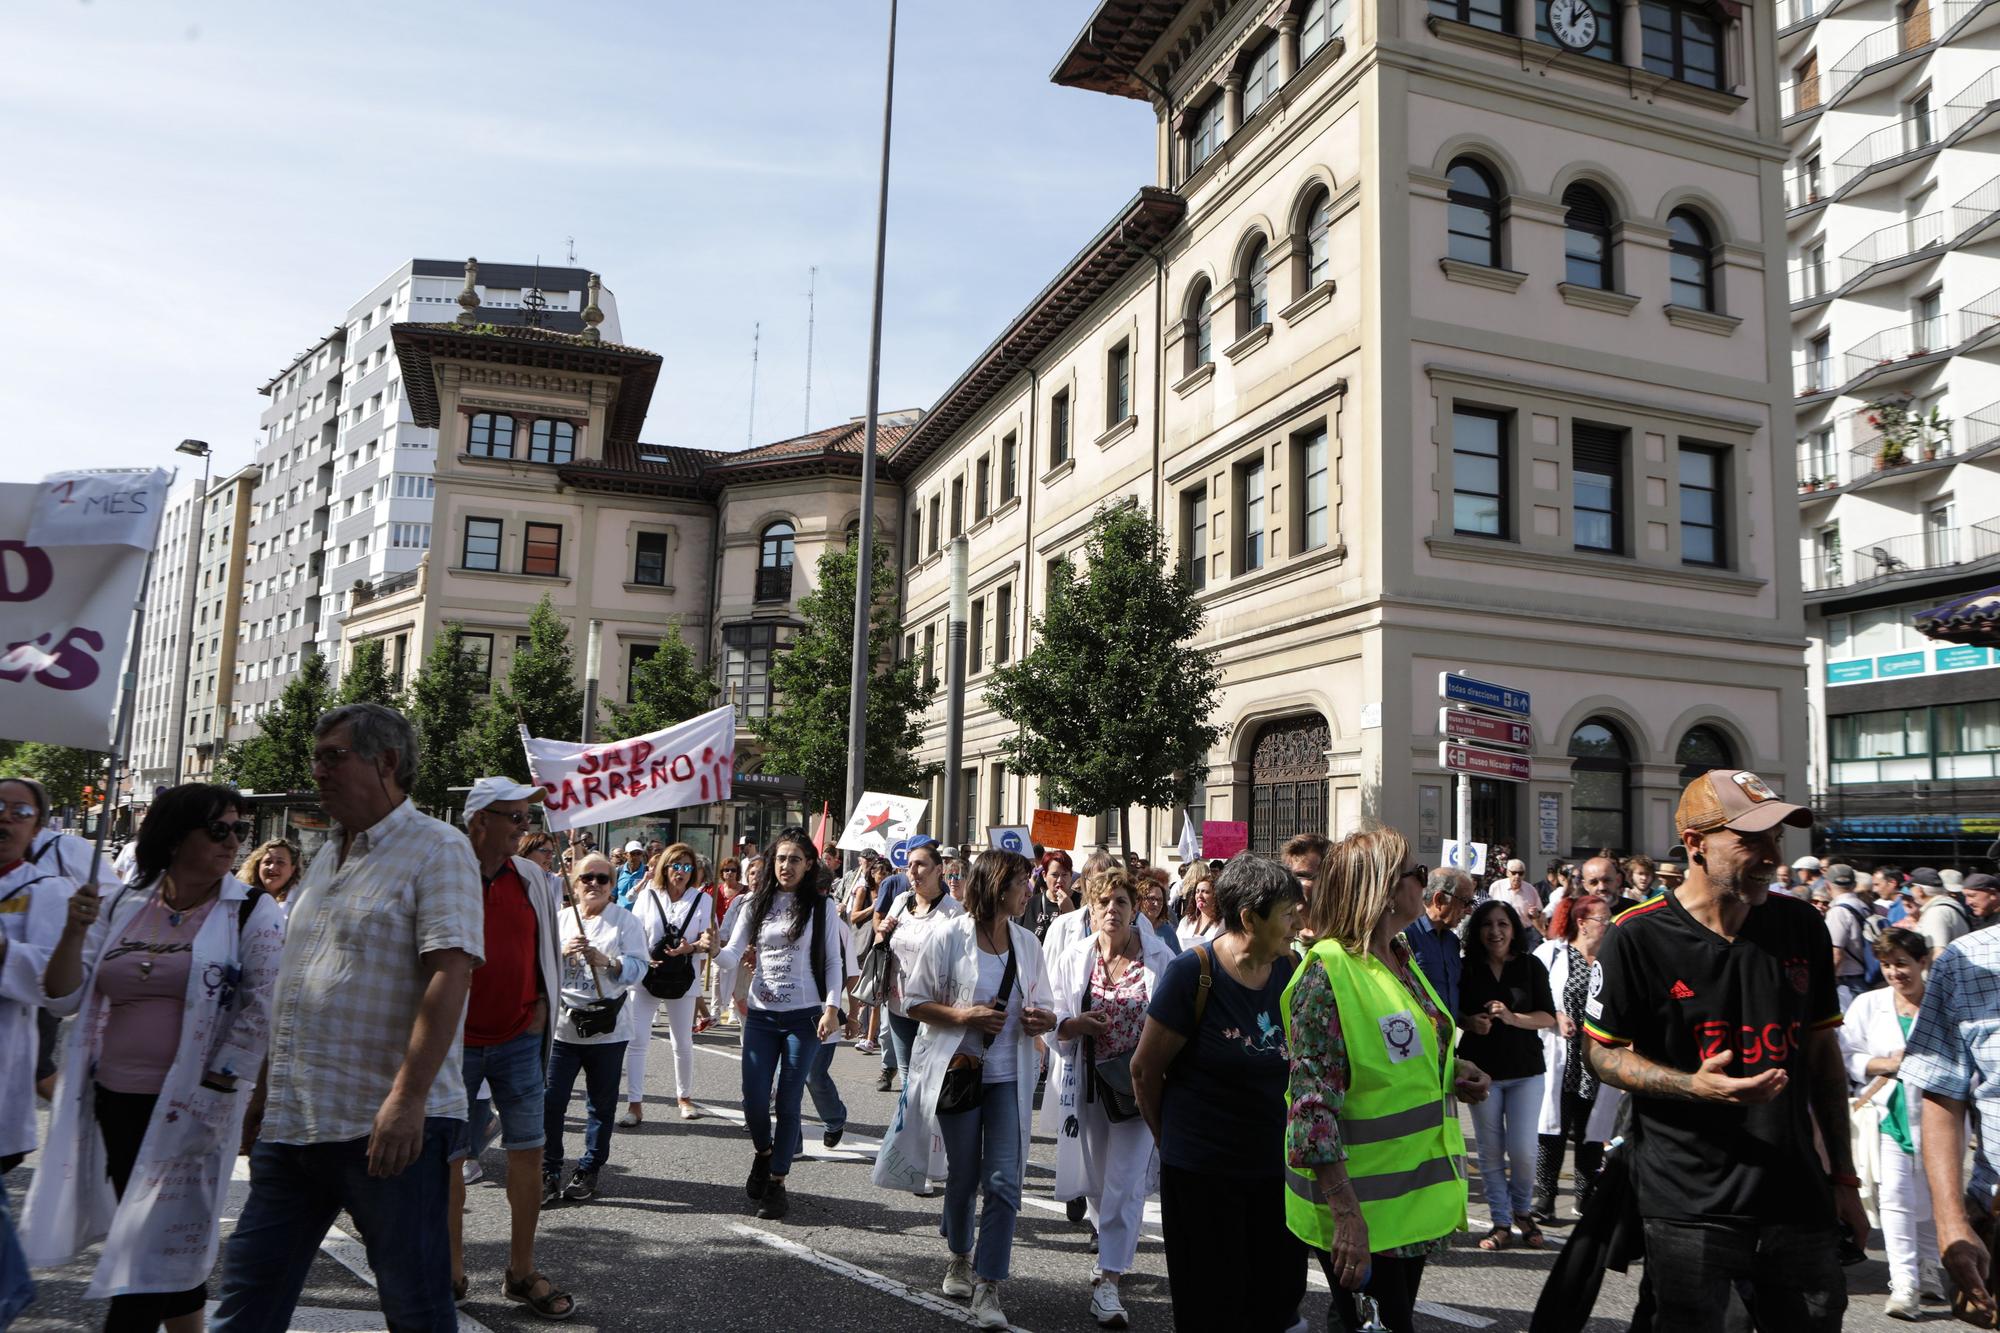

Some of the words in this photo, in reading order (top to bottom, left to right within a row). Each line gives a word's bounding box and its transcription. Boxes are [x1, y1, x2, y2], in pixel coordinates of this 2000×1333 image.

[51, 480, 76, 504] 1
[82, 491, 148, 515] MES
[577, 740, 656, 775] SAD
[1469, 757, 1488, 767] museo
